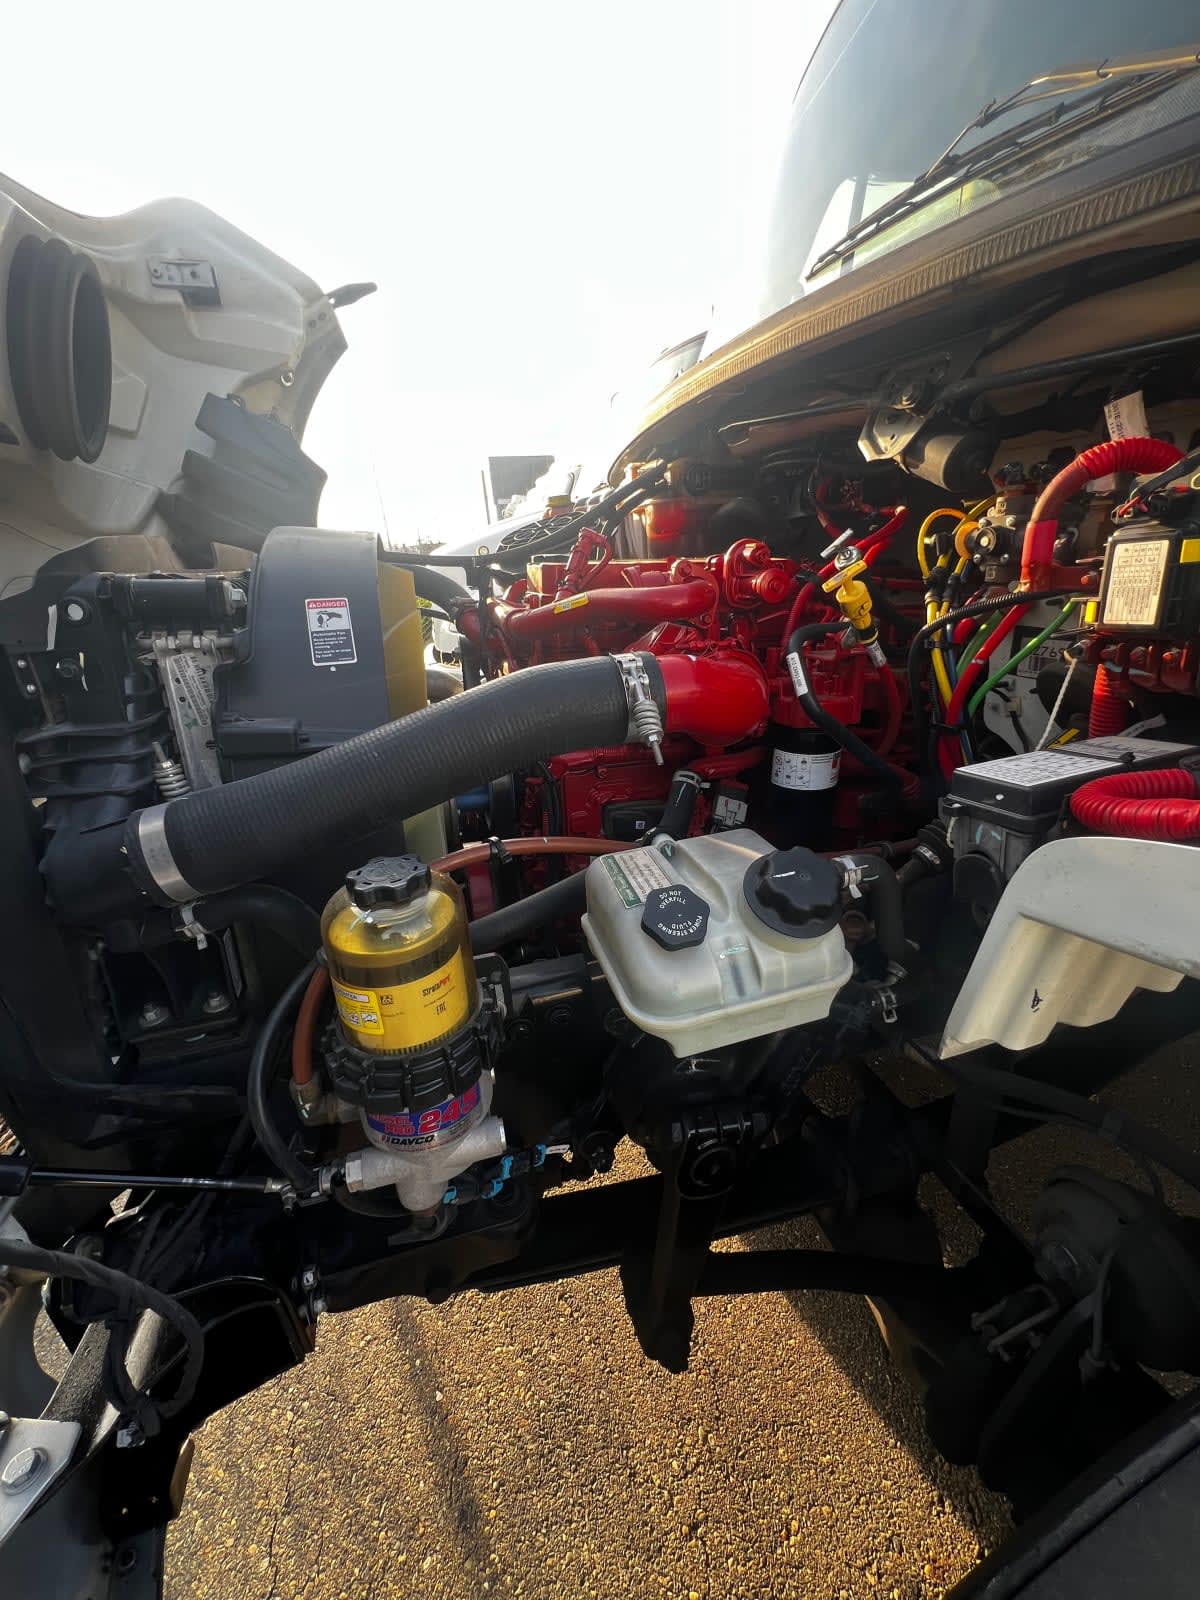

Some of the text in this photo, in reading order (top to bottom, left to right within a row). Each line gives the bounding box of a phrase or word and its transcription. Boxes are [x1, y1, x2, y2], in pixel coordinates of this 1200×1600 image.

[659, 892, 668, 900] DO
[659, 896, 687, 909] OVERFILL
[657, 915, 703, 937] POWER STEERING
[671, 920, 692, 930] FLUID
[390, 1134, 436, 1147] DAVCO
